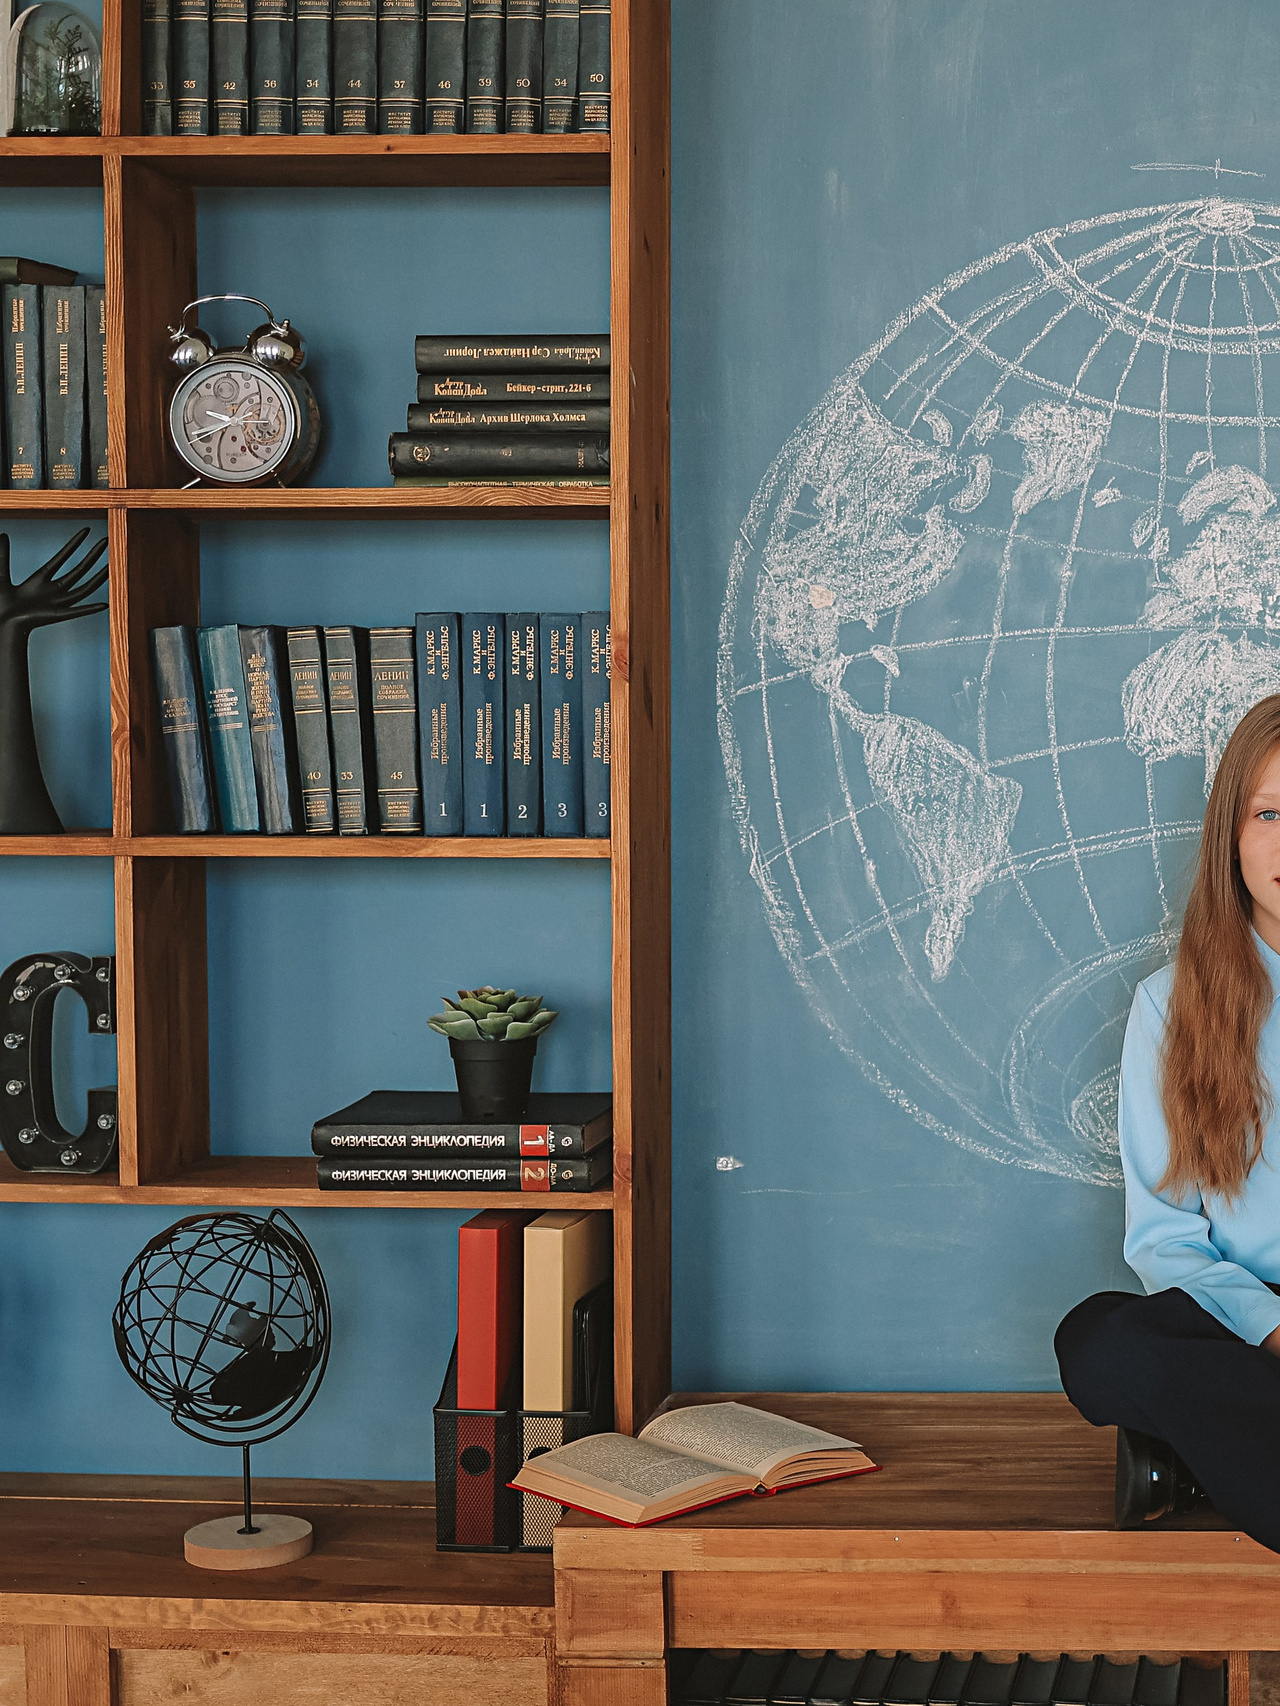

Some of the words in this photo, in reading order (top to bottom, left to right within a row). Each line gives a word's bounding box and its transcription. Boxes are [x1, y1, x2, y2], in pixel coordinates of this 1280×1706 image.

[183, 80, 197, 89] 35
[264, 79, 277, 88] 36
[306, 79, 319, 88] 34
[348, 79, 362, 88] 44
[394, 80, 405, 89] 37
[438, 80, 451, 89] 46
[478, 78, 492, 87] 39
[516, 78, 530, 88] 50
[554, 78, 567, 87] 34
[590, 73, 604, 83] 50
[223, 82, 236, 90] 42
[444, 347, 481, 358] Лоринг
[483, 348, 531, 358] Найджел
[532, 346, 550, 358] Сэр
[480, 414, 509, 424] Архив
[510, 413, 551, 424] Шерлока
[552, 413, 586, 422] Холмса
[17, 447, 24, 455] 7
[59, 447, 66, 455] 8
[426, 630, 435, 675] К.МАРКС
[441, 625, 450, 681] Ф.ЭНГЕЛЬС
[472, 629, 481, 675] К.МАРКС
[487, 625, 496, 681] Ф.ЭНГЕЛЬС
[511, 630, 520, 675] К.МАРКС
[526, 626, 534, 681] Ф.ЭНГЕЛЬС
[551, 629, 559, 674] К.МАРКС
[565, 625, 574, 680] Ф.ЭНГЕЛЬС
[591, 628, 600, 673] К.МАРКС
[294, 671, 317, 680] ЛЕНИН
[374, 670, 409, 680] ЛЕНИН
[431, 708, 439, 759] Избранные
[440, 703, 448, 765] произведения
[475, 708, 484, 759] Избранные
[485, 703, 494, 765] произведения
[513, 708, 522, 759] Избранные
[523, 703, 531, 765] произведения
[552, 707, 561, 759] Избранные
[563, 703, 571, 765] произведения
[593, 707, 601, 758] Избранные
[603, 702, 611, 764] произведения
[307, 772, 321, 780] 40
[341, 771, 353, 780] 33
[390, 771, 403, 780] 45
[440, 802, 448, 817] 1
[480, 803, 488, 818] 1
[518, 804, 528, 819] 2
[558, 803, 568, 817] 3
[598, 802, 607, 817] 3
[331, 1135, 406, 1147] ФИЗИЧЕСКАЯ
[411, 1135, 505, 1148] ЭНЦИКЛОПЕДИЯ
[523, 1134, 545, 1145] 1
[331, 1169, 407, 1181] ФИЗИЧЕСКАЯ
[411, 1169, 506, 1182] ЭНЦИКЛОПЕДИЯ
[524, 1167, 545, 1182] 2
